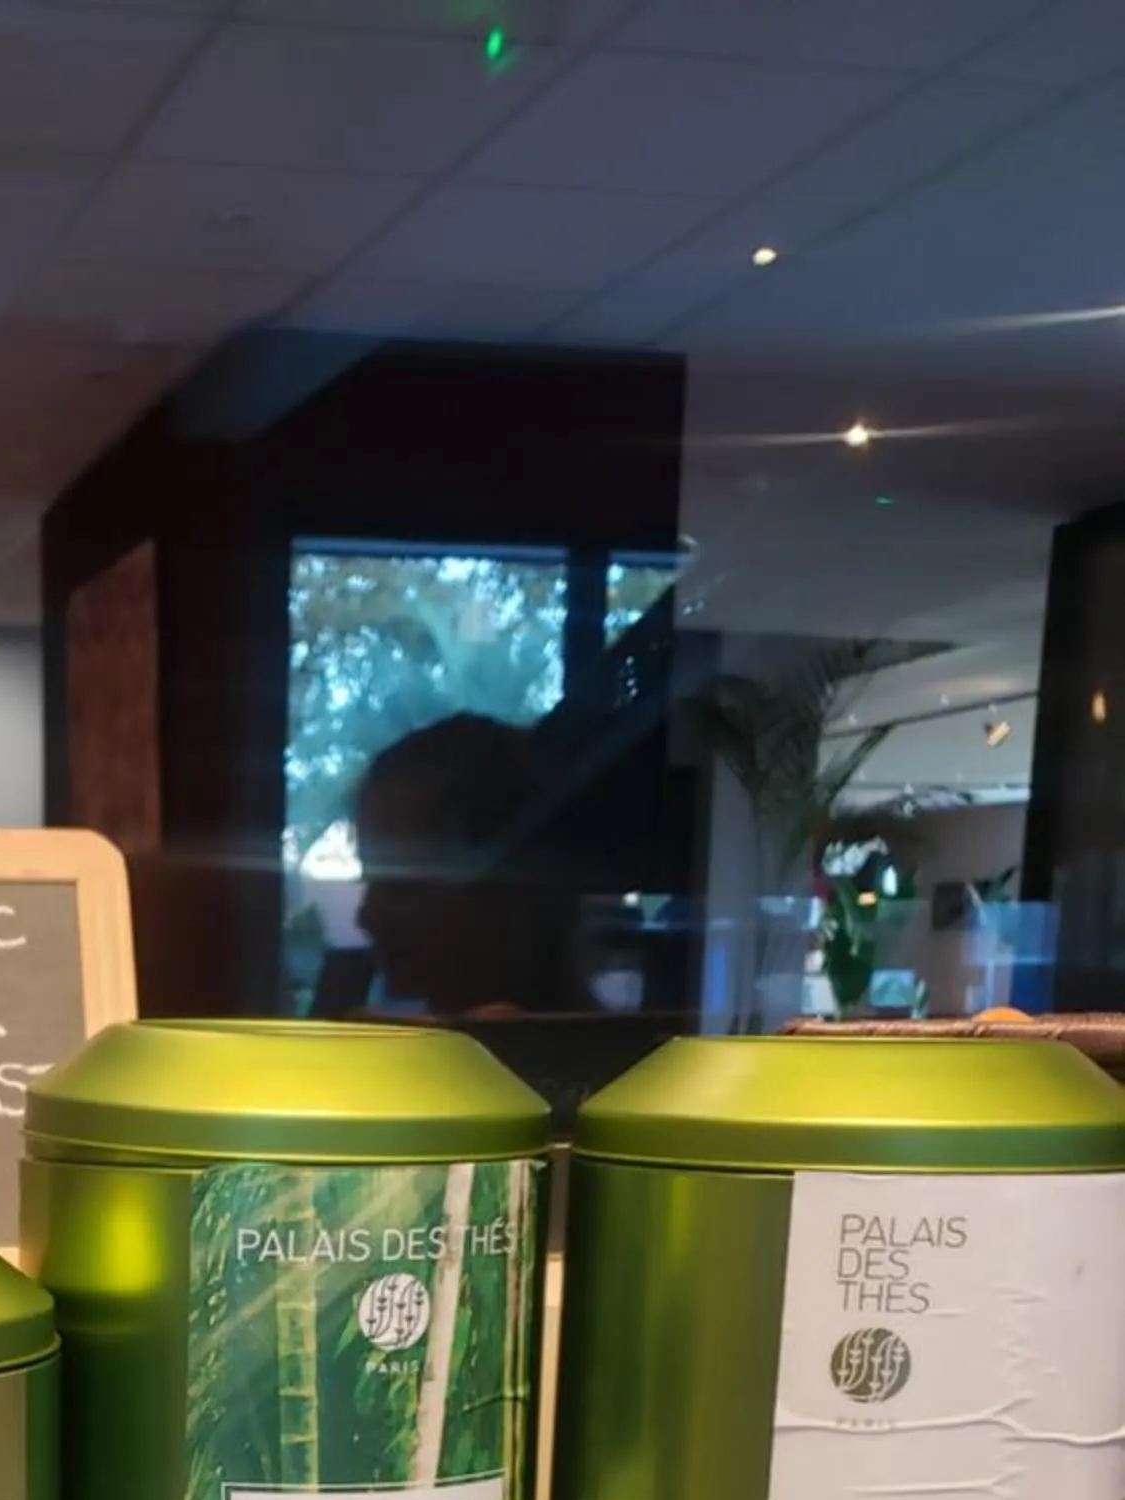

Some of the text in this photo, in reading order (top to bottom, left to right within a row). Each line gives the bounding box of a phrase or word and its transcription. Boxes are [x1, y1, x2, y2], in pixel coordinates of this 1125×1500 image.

[237, 1227, 372, 1262] PALAIS
[382, 1226, 448, 1261] DES
[840, 1213, 968, 1248] PALAIS
[837, 1247, 911, 1281] DES
[365, 1360, 420, 1374] PARIS
